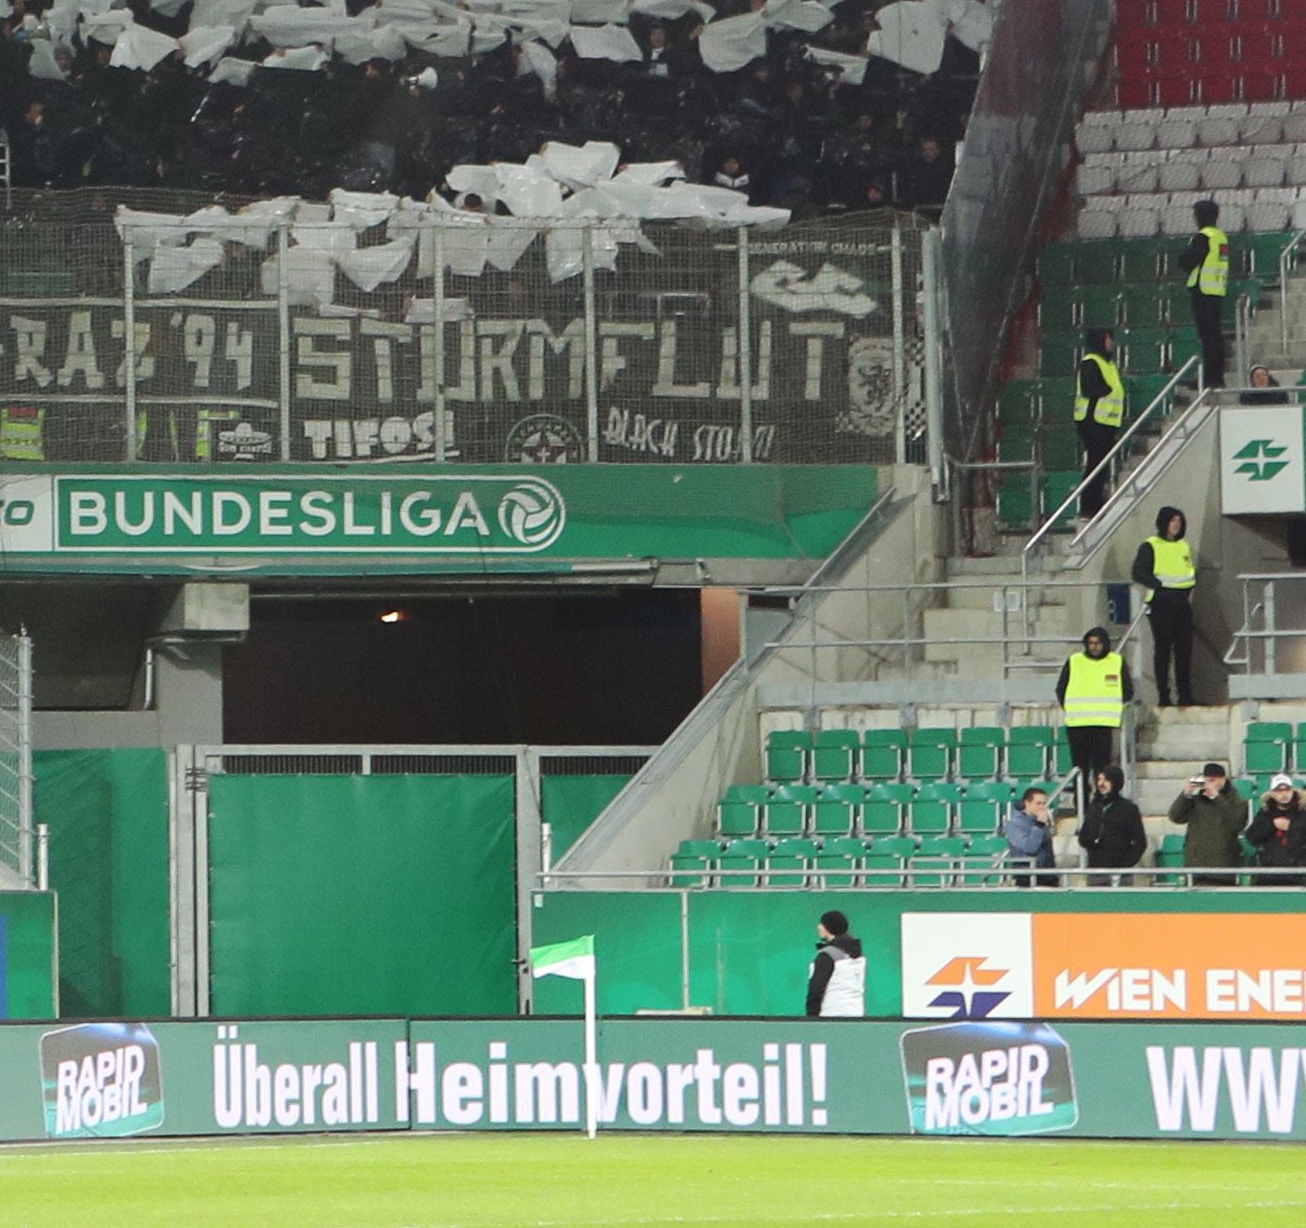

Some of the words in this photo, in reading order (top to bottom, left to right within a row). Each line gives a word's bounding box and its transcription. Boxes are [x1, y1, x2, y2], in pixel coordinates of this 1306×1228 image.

[294, 318, 845, 401] STURMFLUT
[69, 490, 491, 537] BUNDESLIGA
[1054, 967, 1188, 1012] WIEN
[1205, 968, 1306, 1013] ENE
[57, 1045, 145, 1097] RAPID
[212, 1025, 378, 1128] Überall
[395, 1041, 828, 1126] Heimvorteil!
[927, 1044, 1050, 1094] RAPID
[1144, 1046, 1306, 1133] WW
[55, 1077, 148, 1135] MOBIL
[925, 1077, 1054, 1131] MOBIL
